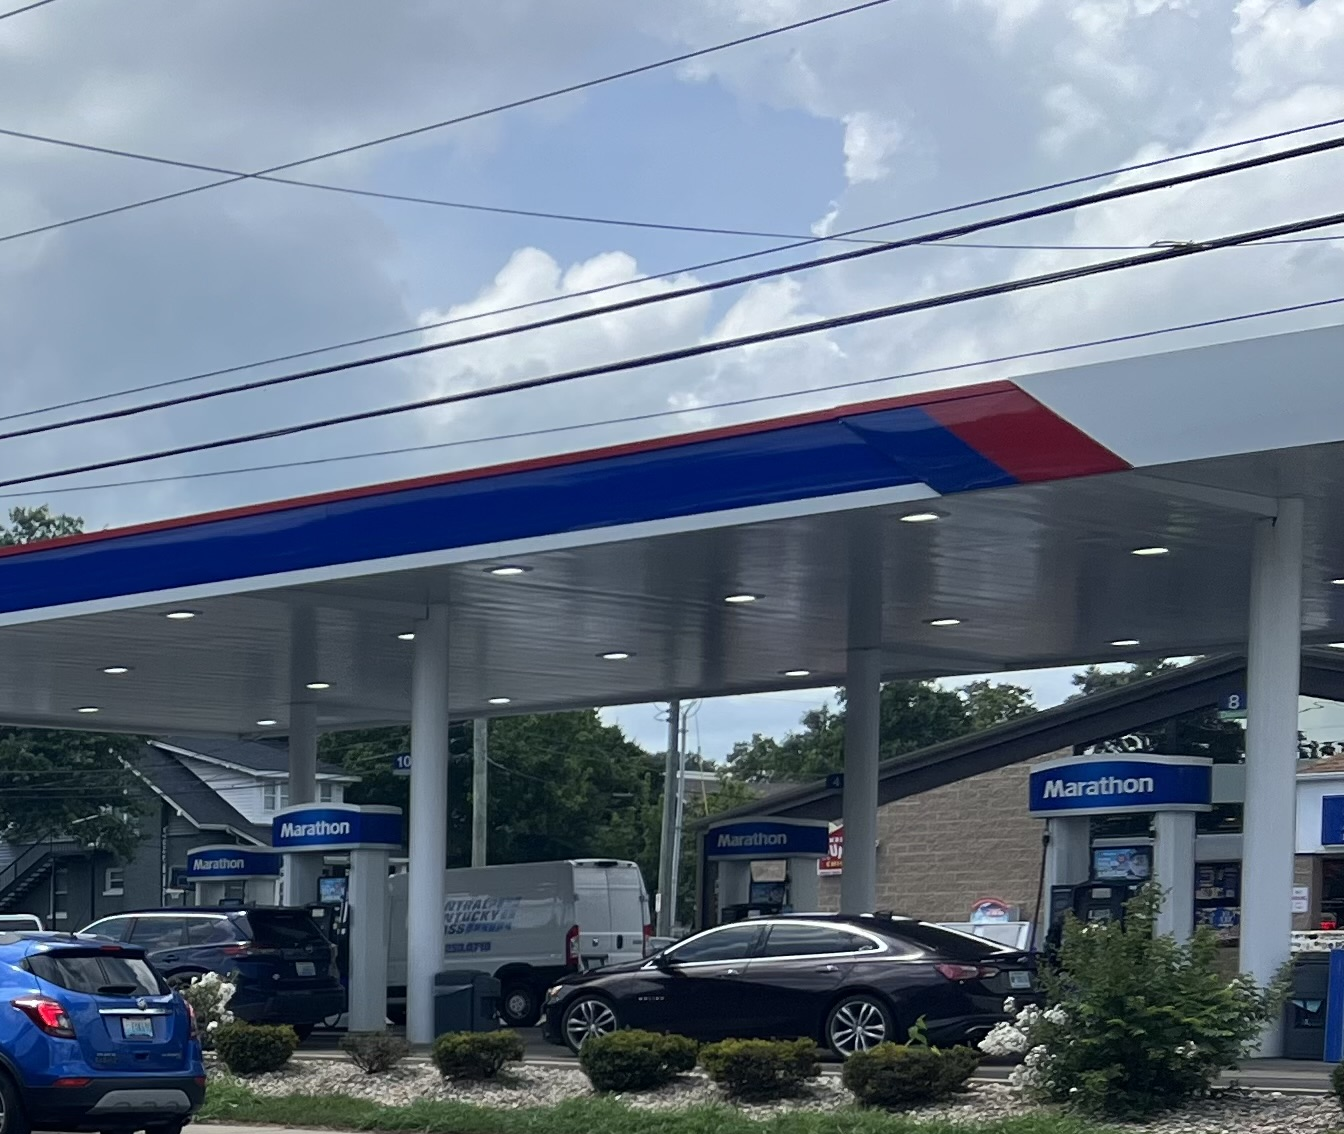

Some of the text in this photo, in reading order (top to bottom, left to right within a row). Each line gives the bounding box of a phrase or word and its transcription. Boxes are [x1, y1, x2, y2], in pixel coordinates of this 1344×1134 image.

[1228, 694, 1240, 710] 8
[397, 755, 411, 768] 10
[1043, 776, 1154, 799] Marathon
[280, 820, 350, 838] Marathon
[717, 832, 787, 847] Marathon
[193, 858, 245, 871] Marathon
